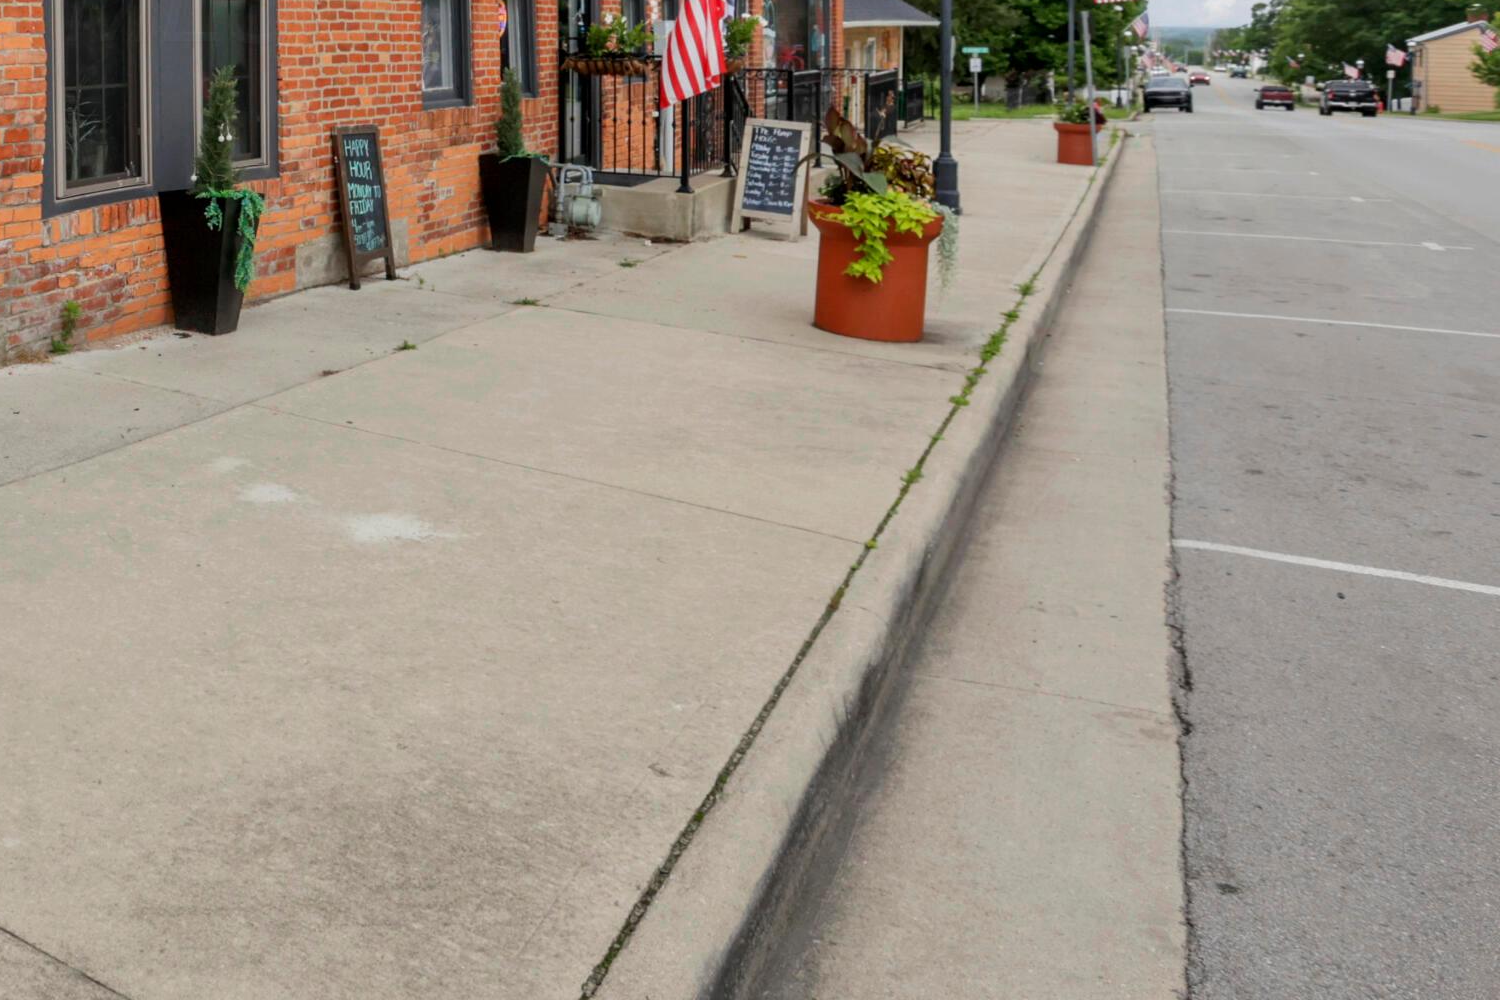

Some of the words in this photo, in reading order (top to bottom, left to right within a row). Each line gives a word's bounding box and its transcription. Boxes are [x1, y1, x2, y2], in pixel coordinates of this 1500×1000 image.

[343, 138, 369, 157] HAPPY
[349, 160, 372, 180] HOUR
[347, 182, 372, 199] MONDAY
[349, 199, 374, 215] FRIDAY
